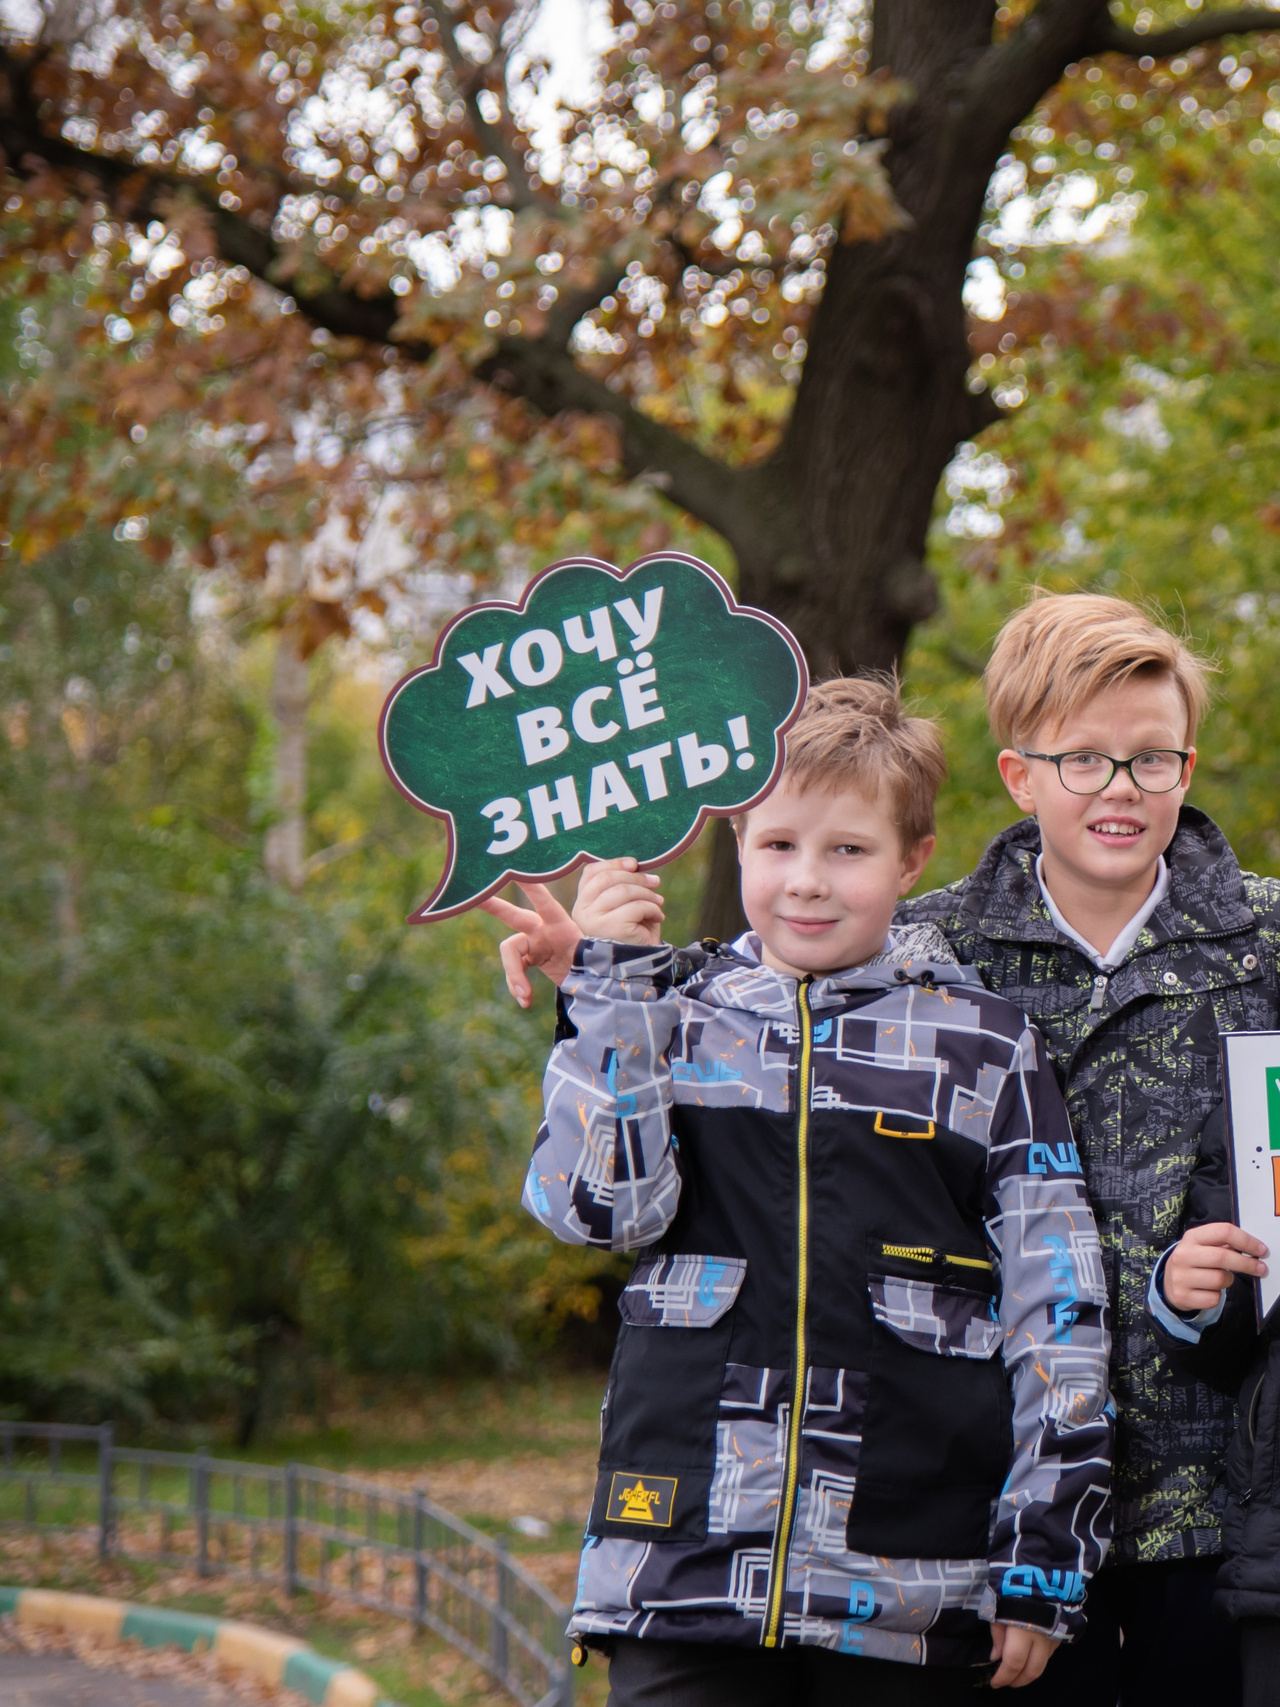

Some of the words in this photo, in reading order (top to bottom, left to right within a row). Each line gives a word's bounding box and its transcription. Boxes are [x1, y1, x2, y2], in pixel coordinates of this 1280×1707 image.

[456, 586, 664, 709] ХОЧУ
[516, 651, 665, 766] ВСЁ
[479, 715, 755, 855] ЗНАТЬ!
